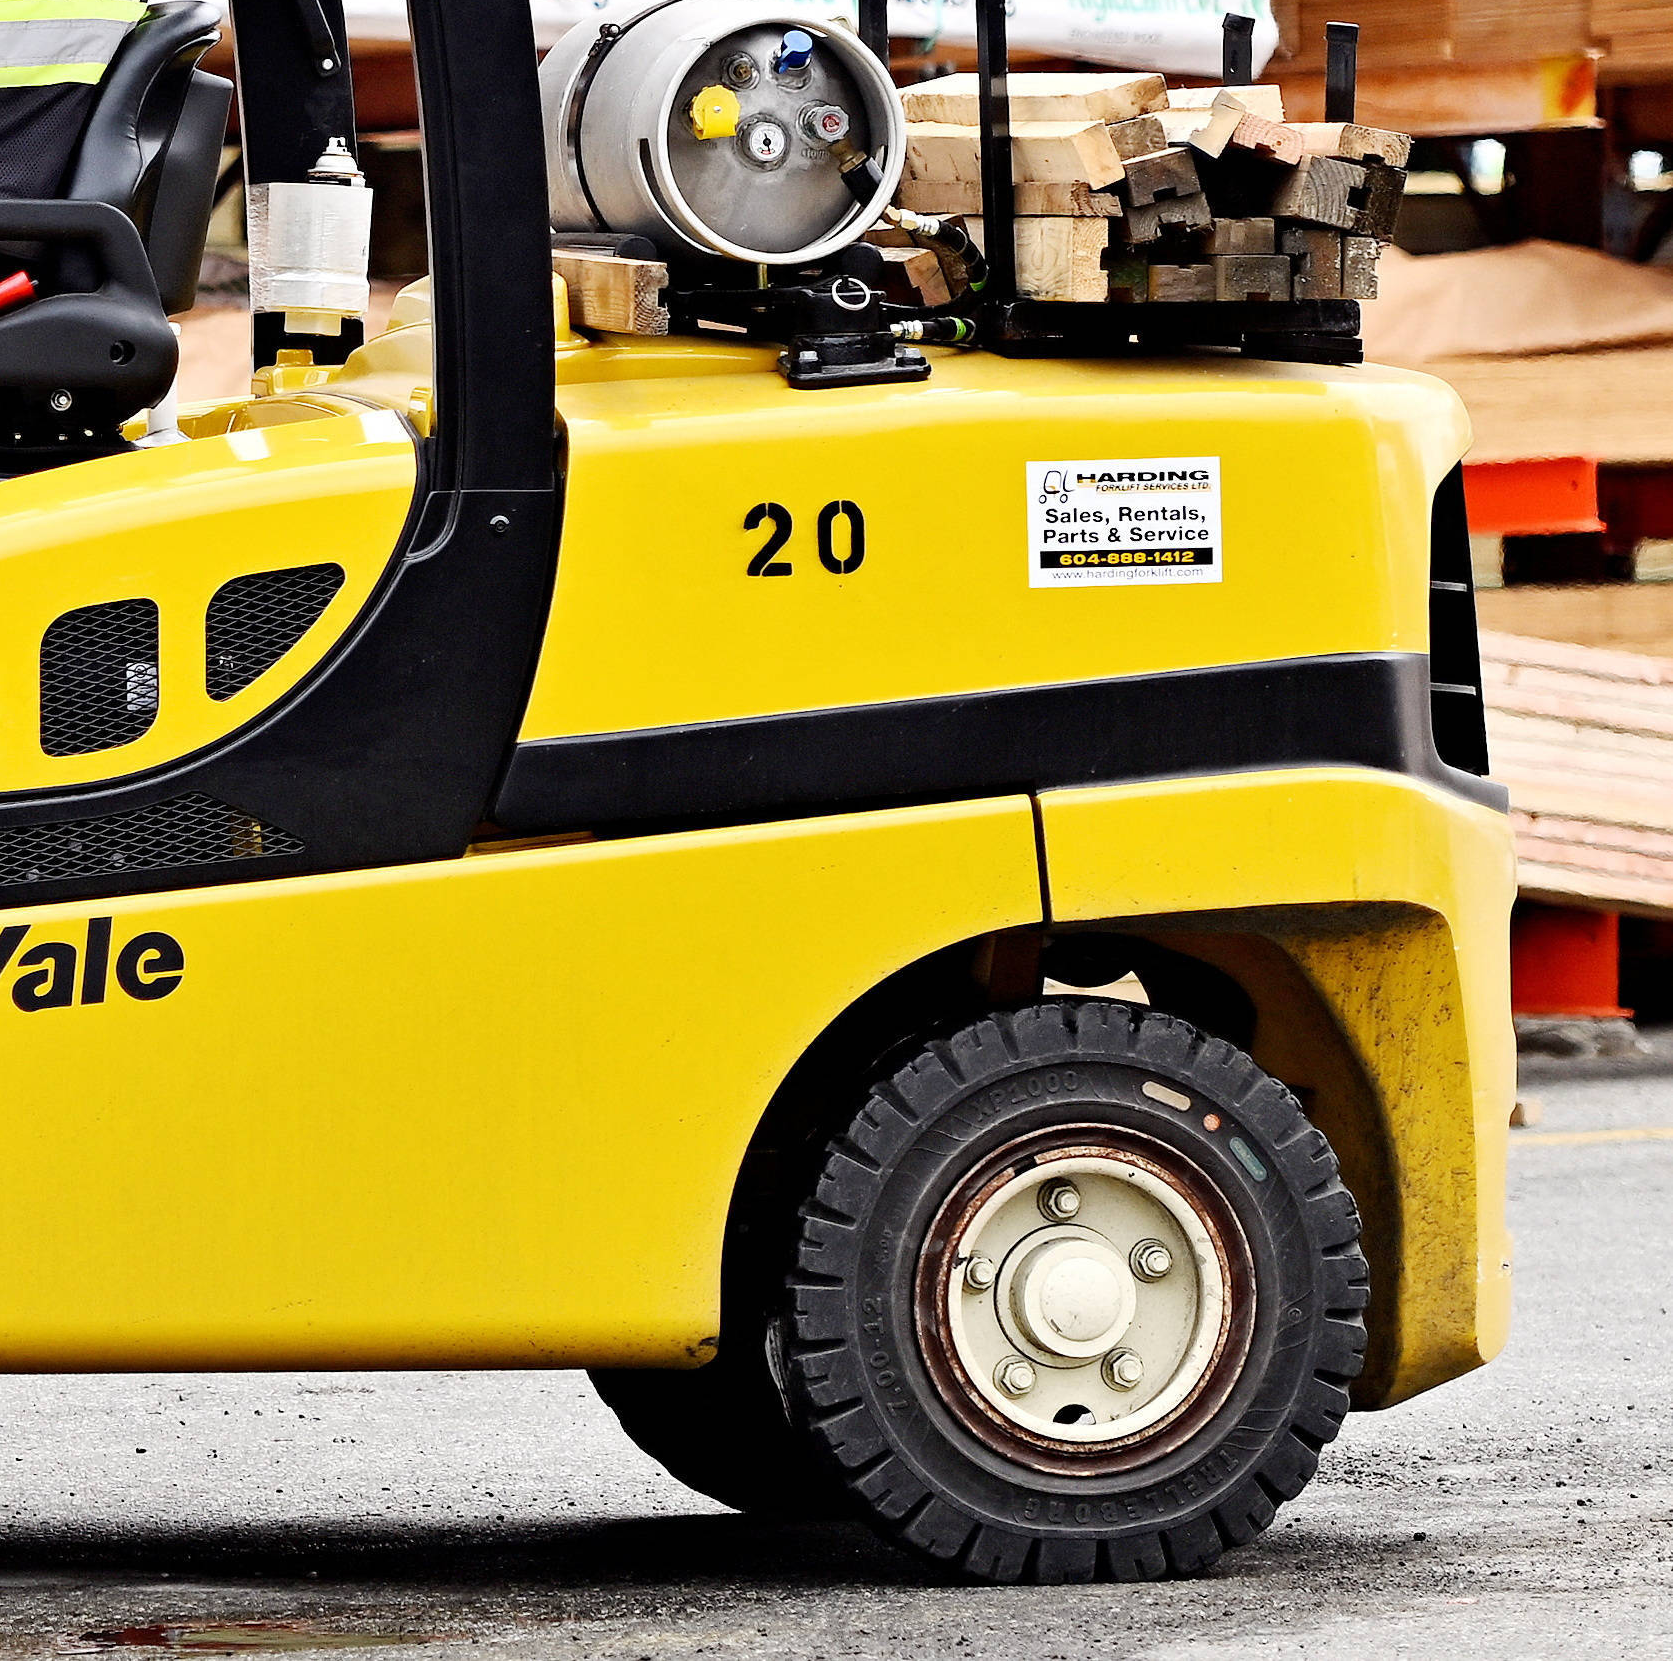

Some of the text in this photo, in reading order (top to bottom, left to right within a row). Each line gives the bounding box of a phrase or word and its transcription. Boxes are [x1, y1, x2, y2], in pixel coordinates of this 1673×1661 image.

[1076, 470, 1210, 484] HARDING
[1096, 483, 1140, 492] FORKLIFT
[1143, 482, 1189, 491] SERVICES
[1045, 505, 1206, 525] Sales, Rentals,
[742, 499, 866, 578] 20
[1043, 526, 1209, 544] Parts & Service
[1059, 550, 1195, 566] 604-888-1412
[1052, 567, 1204, 580] www.hardingforklift.com
